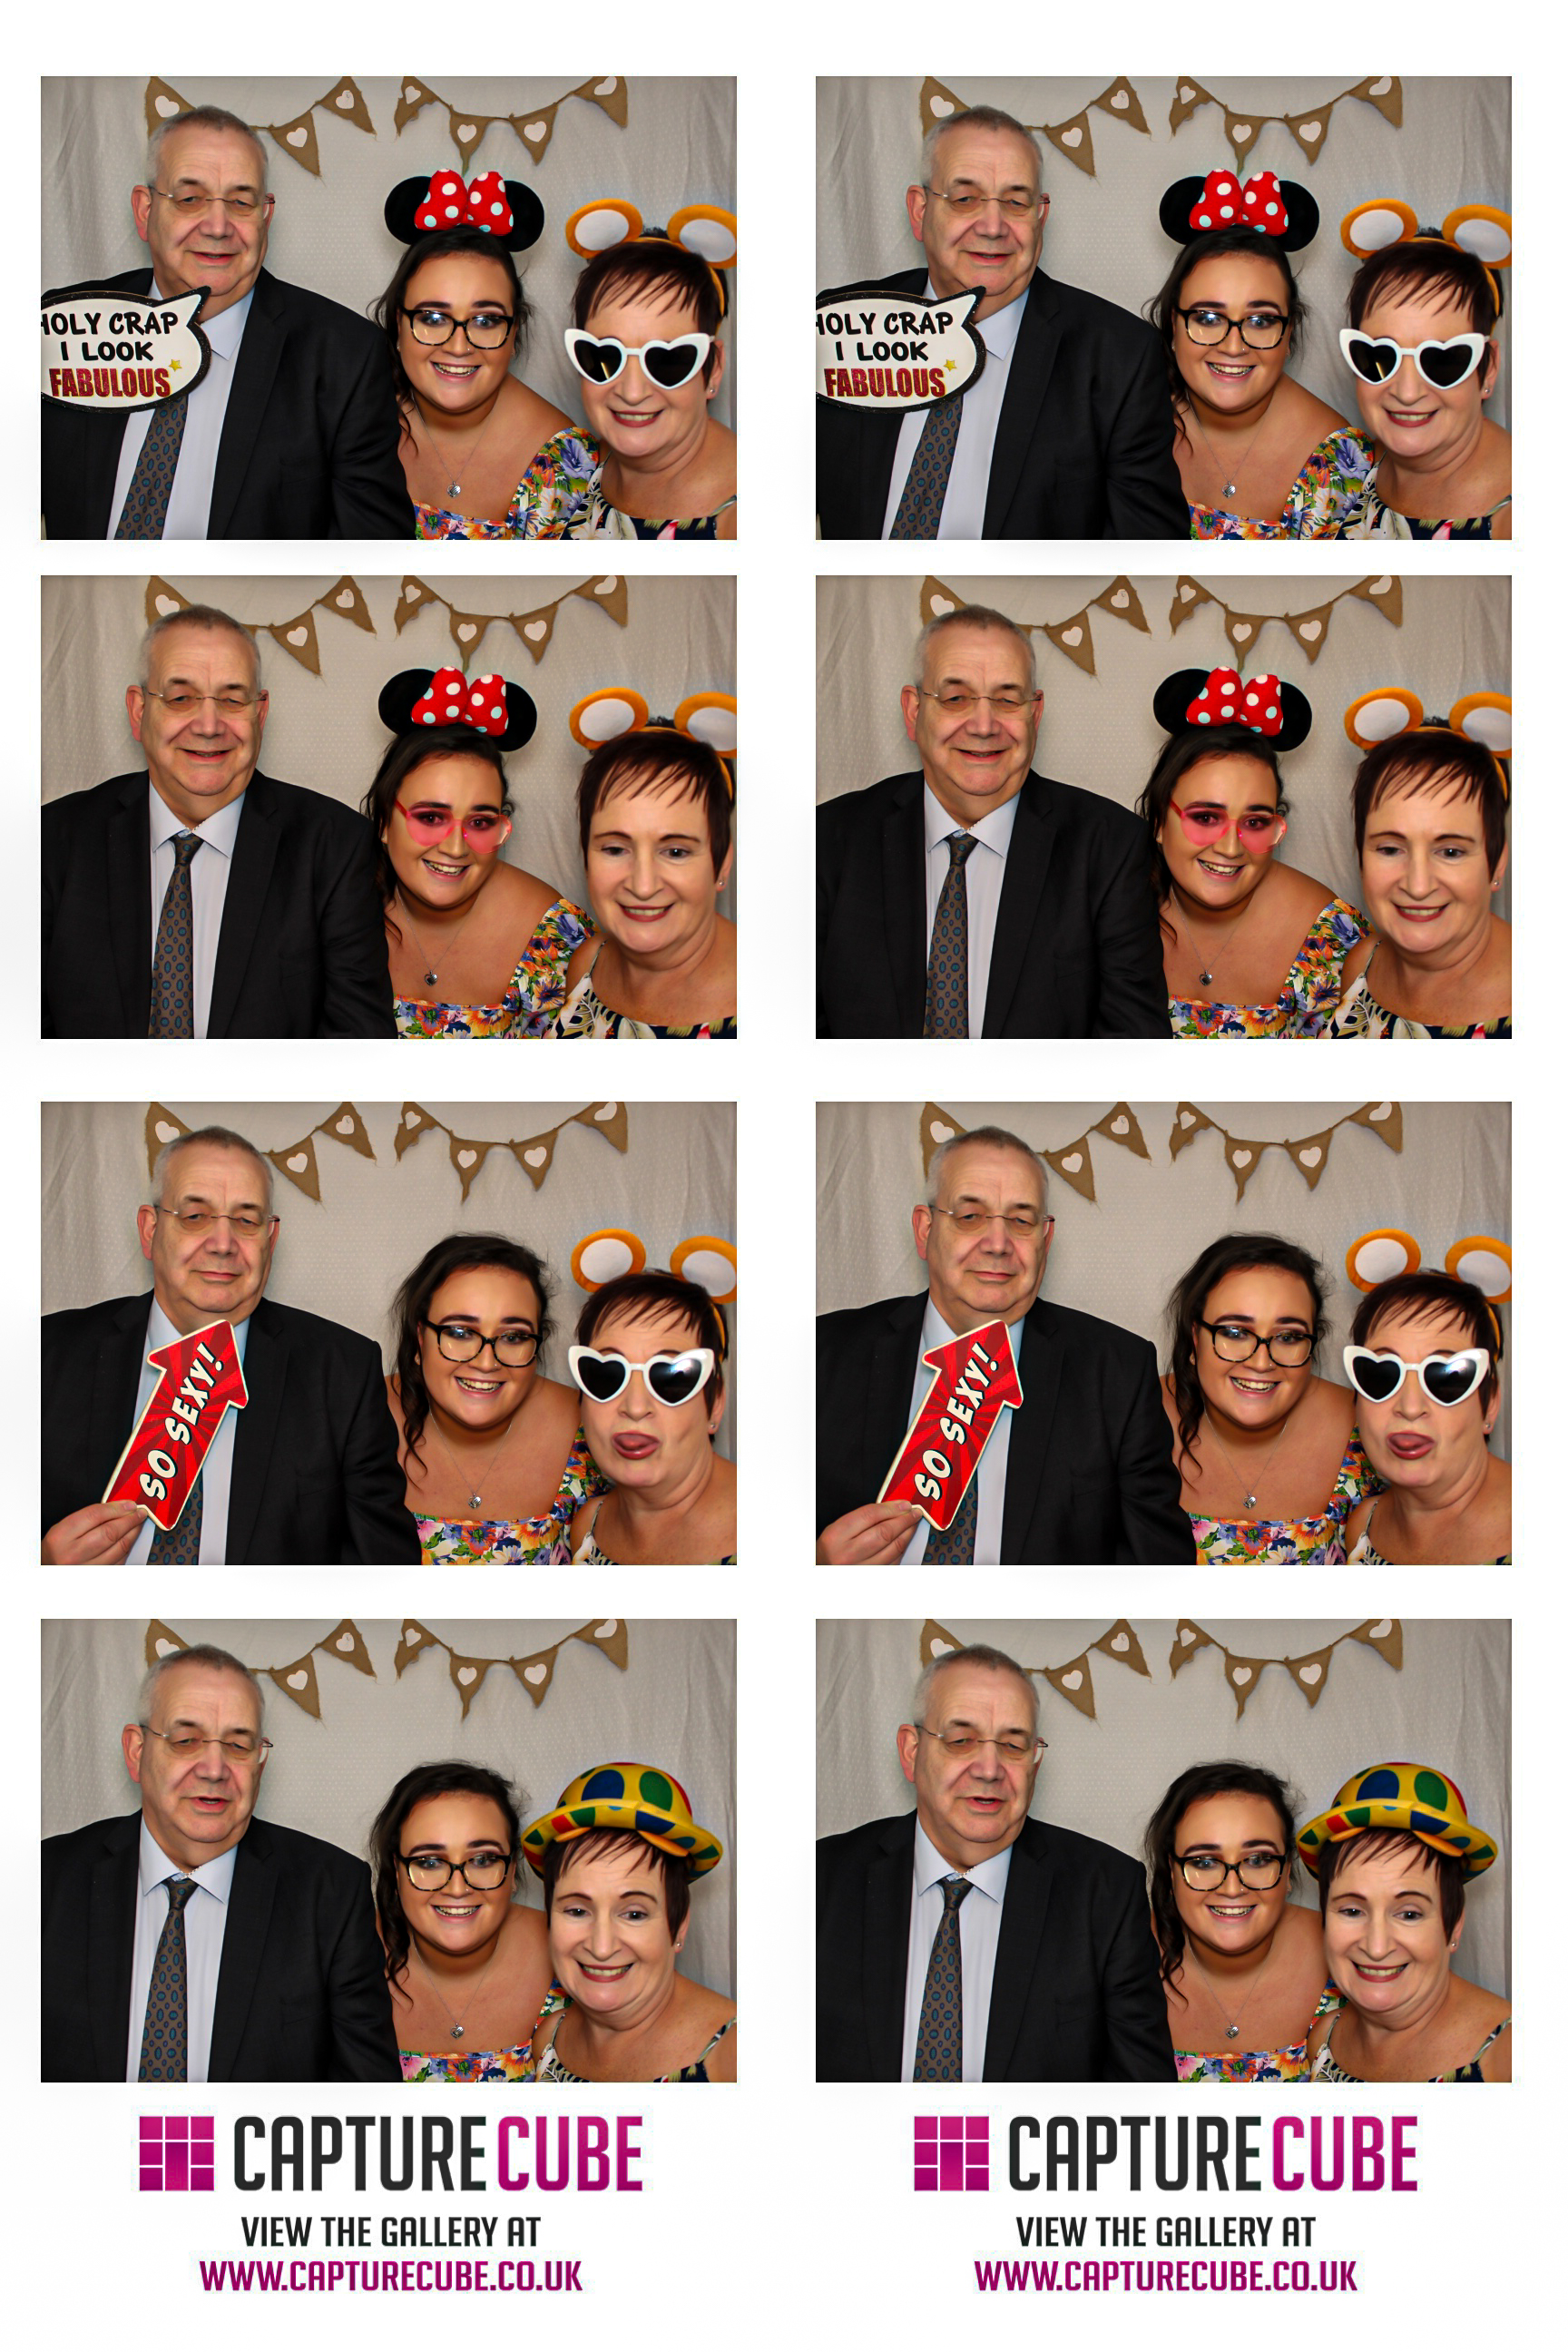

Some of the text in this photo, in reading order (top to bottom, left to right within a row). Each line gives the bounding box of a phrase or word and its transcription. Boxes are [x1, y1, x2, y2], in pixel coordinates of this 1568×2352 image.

[109, 311, 179, 336] CRAP
[884, 311, 954, 336] CRAP
[60, 341, 154, 361] I LOOK
[835, 341, 929, 361] I LOOK
[48, 368, 172, 397] FABULOUS
[823, 368, 946, 397] FABULOUS
[139, 1341, 224, 1501] SO SEXY!
[914, 1341, 999, 1501] SO SEXY!
